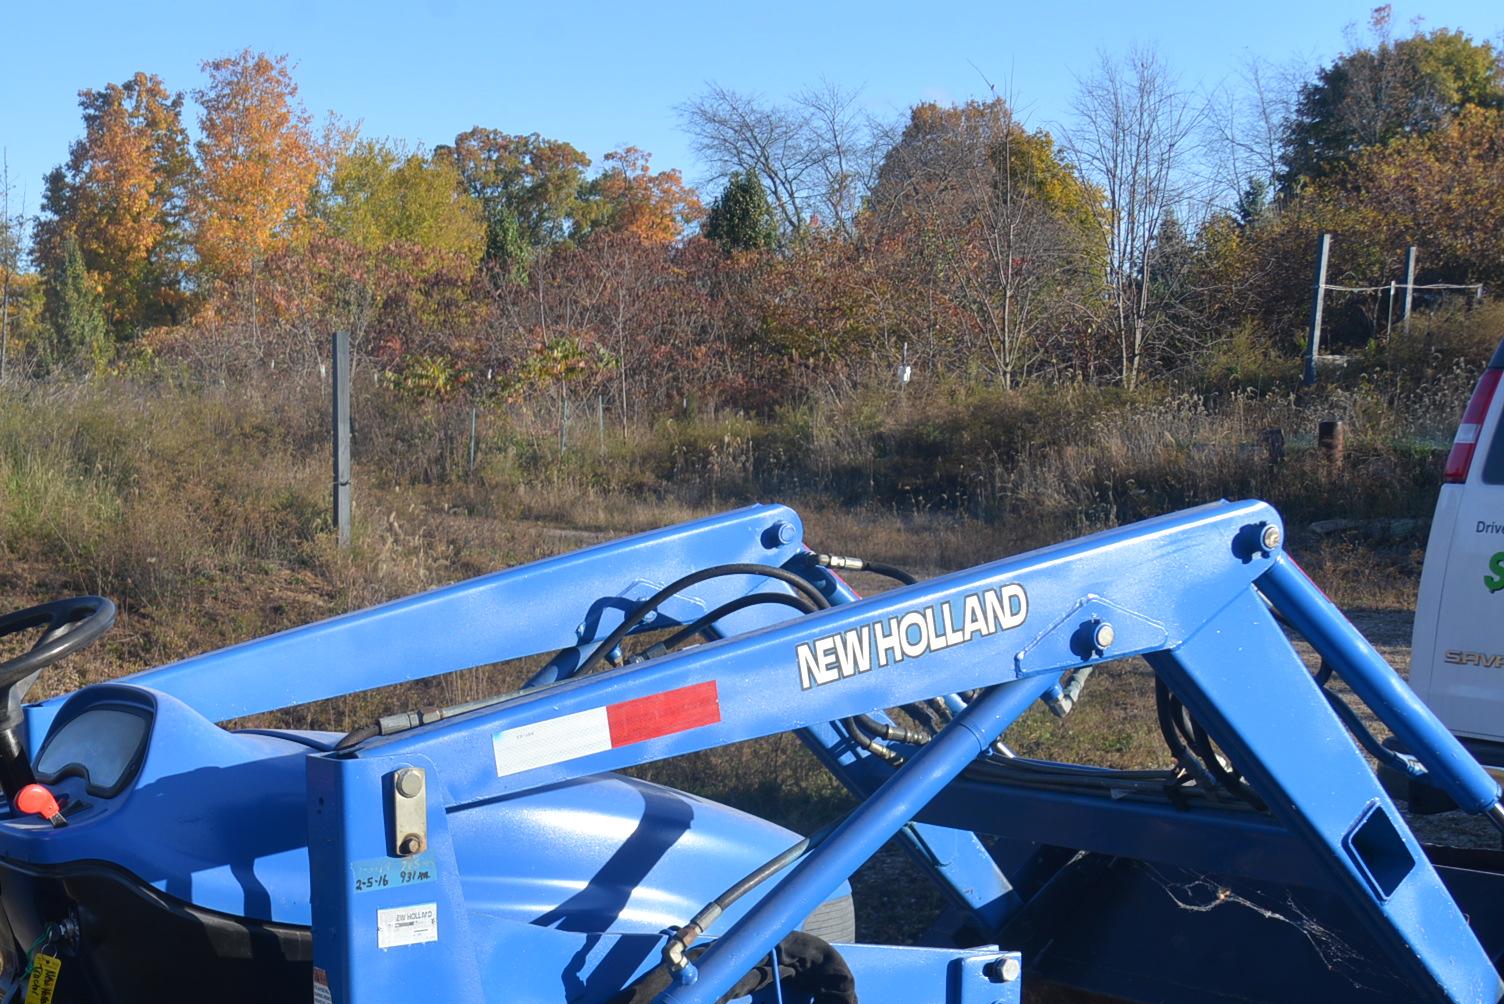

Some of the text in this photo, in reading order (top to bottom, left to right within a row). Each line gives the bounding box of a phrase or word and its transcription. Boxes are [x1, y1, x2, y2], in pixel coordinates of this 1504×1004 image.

[796, 582, 1029, 691] NEW HOLLAND
[356, 874, 389, 891] 2-5-16
